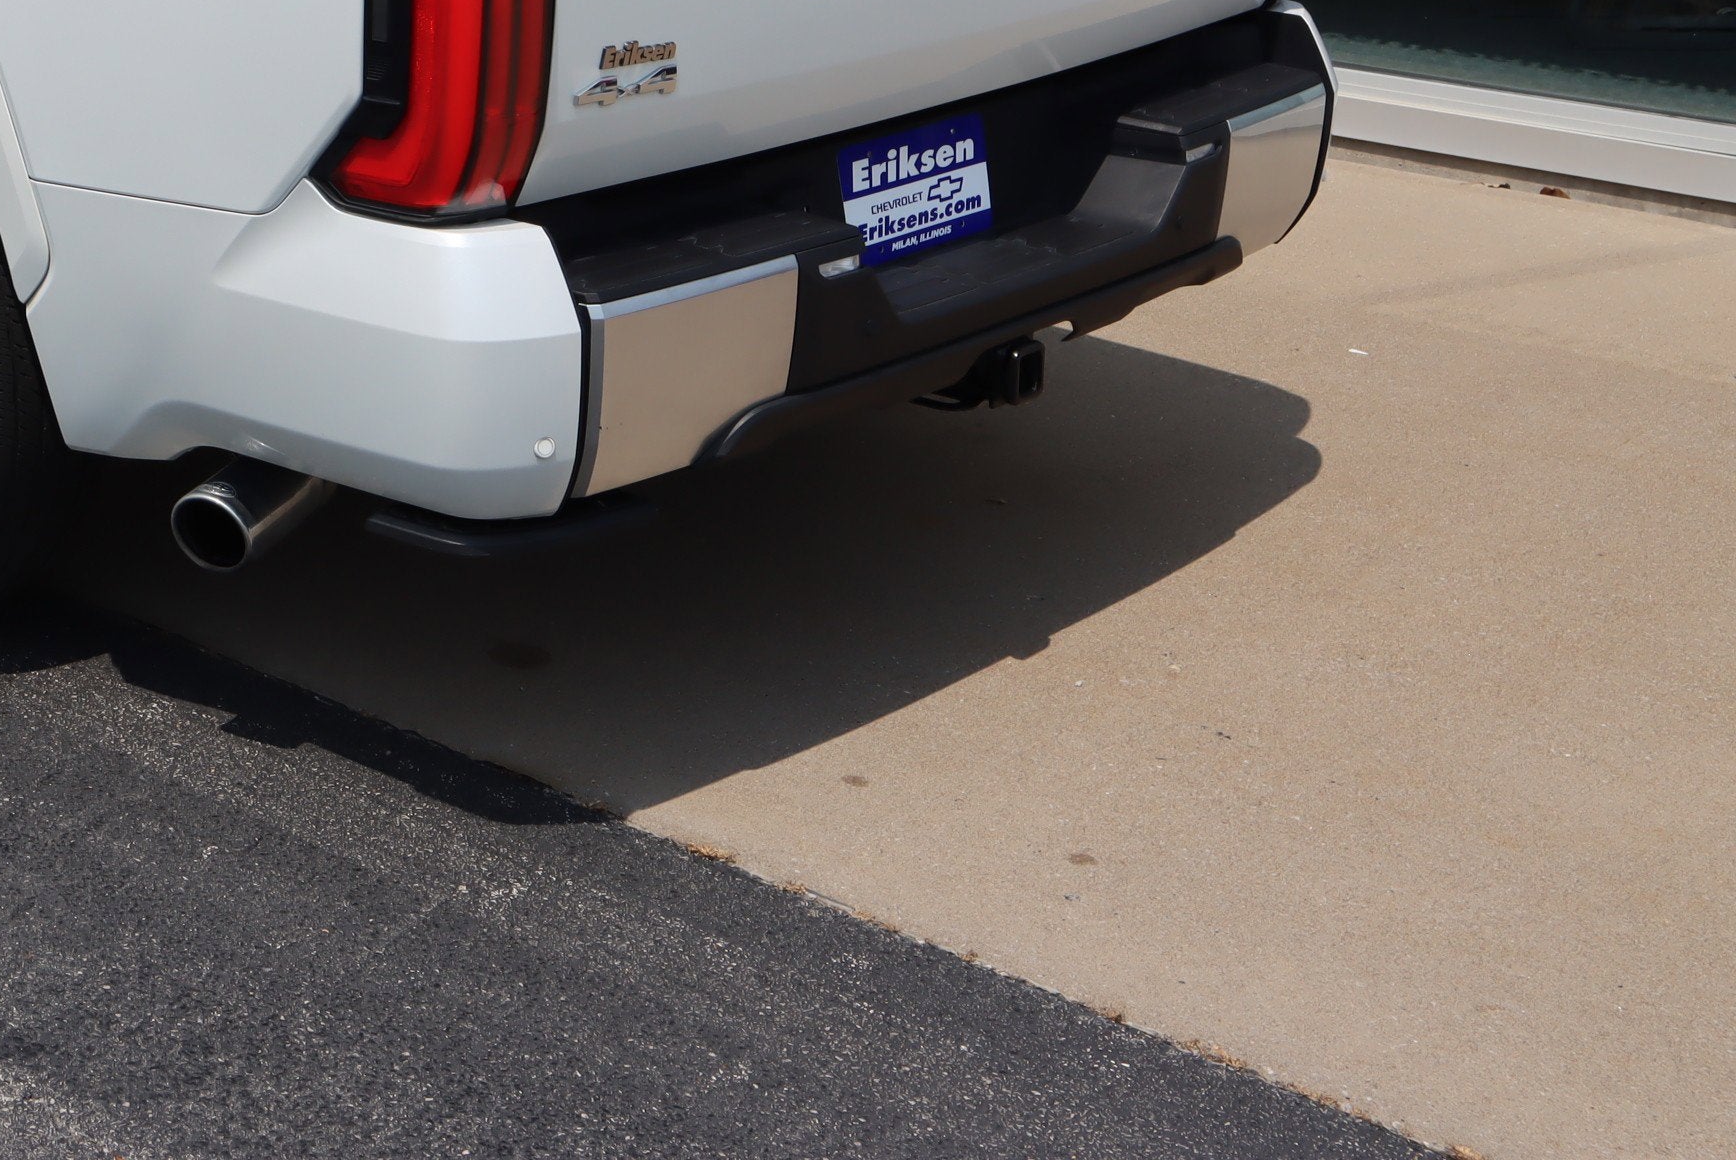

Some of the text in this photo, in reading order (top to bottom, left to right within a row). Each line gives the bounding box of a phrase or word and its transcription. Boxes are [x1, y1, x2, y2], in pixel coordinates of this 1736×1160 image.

[599, 40, 676, 69] Eriksen
[572, 63, 678, 107] 4x4
[852, 138, 975, 193] Eriksen
[871, 191, 923, 215] CHEVROLET
[891, 225, 952, 252] MILAN, ILLINOIS
